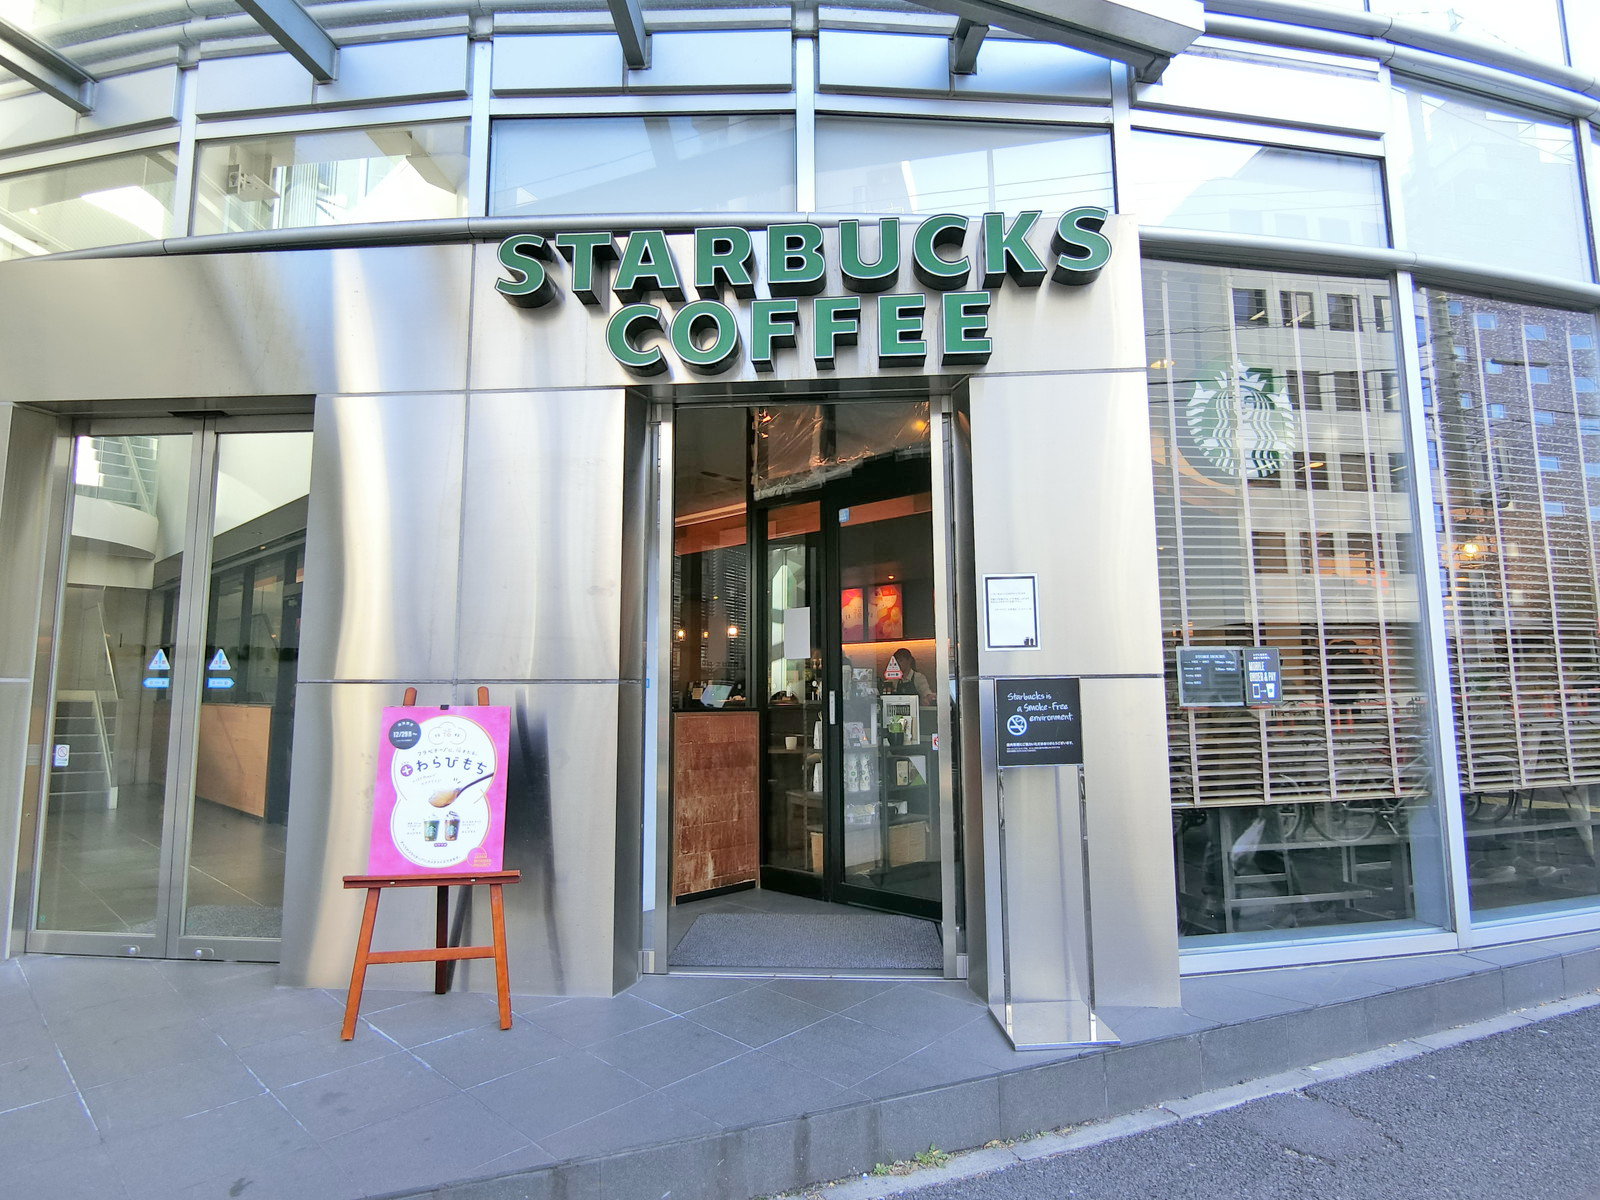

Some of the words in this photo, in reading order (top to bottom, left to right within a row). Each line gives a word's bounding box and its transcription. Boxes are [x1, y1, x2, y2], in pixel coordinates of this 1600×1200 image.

[495, 206, 1113, 305] STARBUCKS
[604, 290, 992, 376] COFFEE
[1248, 661, 1265, 671] MOBILE
[1249, 671, 1263, 681] ORDER
[1007, 691, 1045, 701] Starbucks
[1046, 692, 1052, 700] is
[1029, 712, 1074, 722] environment.
[416, 755, 488, 775] わらびもち
